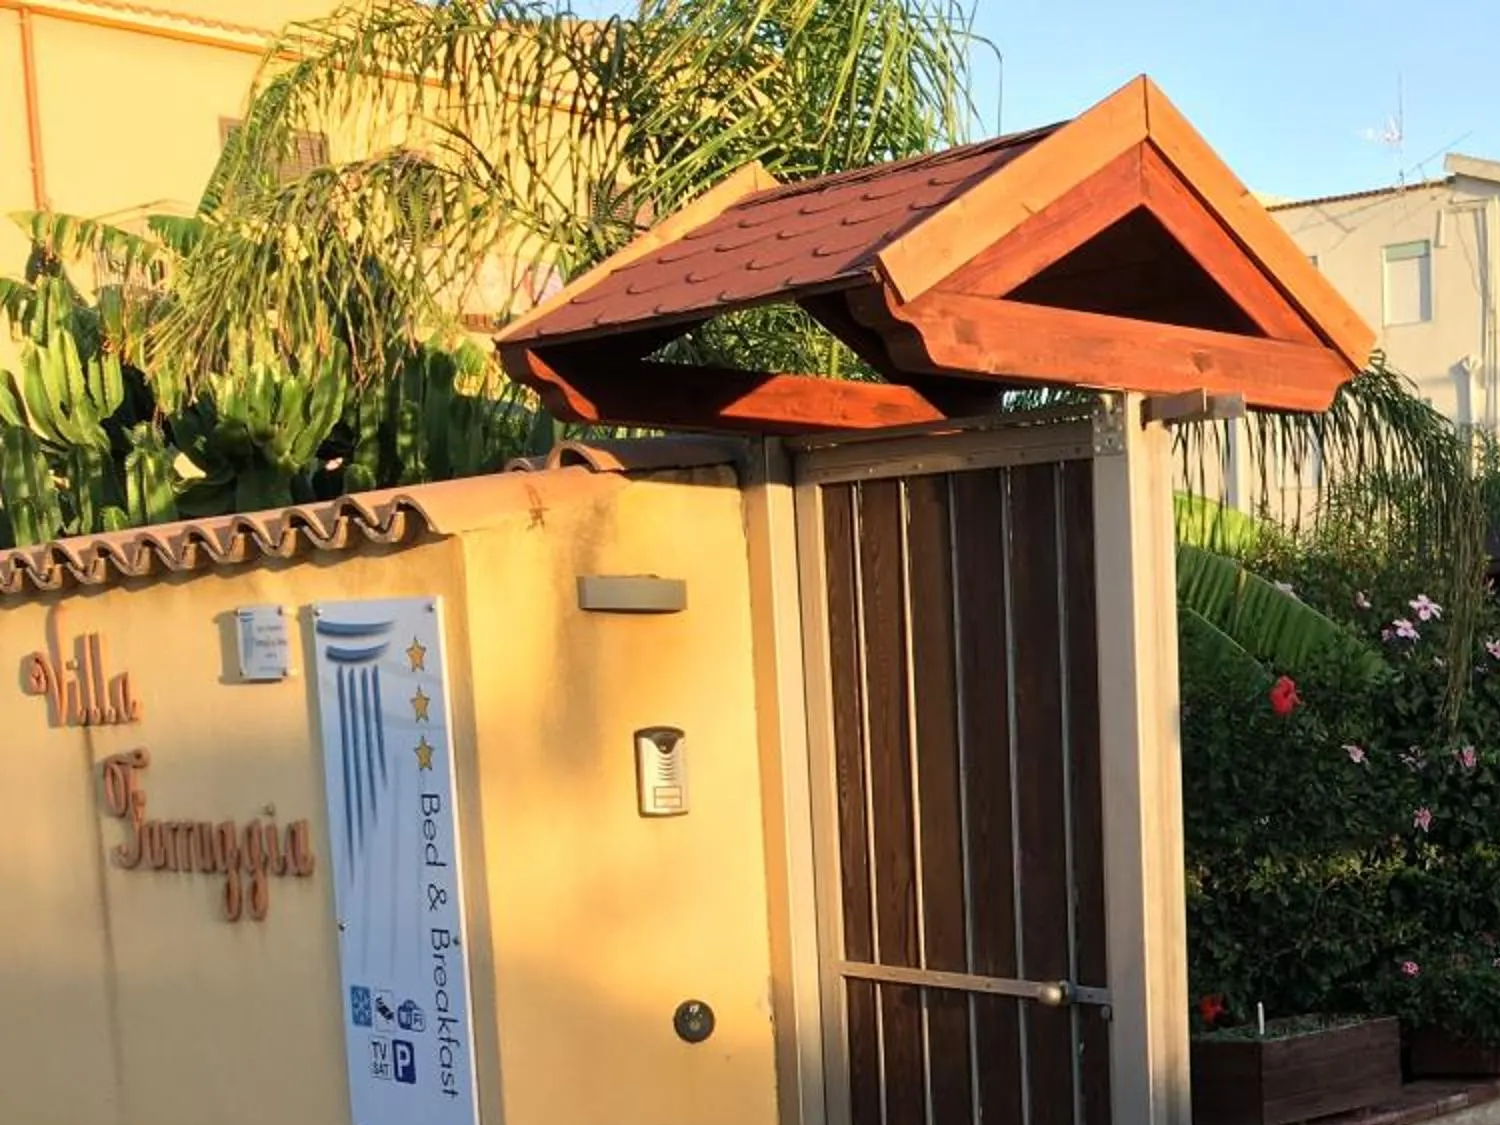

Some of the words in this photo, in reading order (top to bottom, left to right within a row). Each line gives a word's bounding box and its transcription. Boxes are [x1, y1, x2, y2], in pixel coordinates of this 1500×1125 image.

[24, 600, 141, 727] Villa
[420, 793, 447, 867] Bed
[427, 883, 447, 912] &
[430, 927, 460, 1099] Breakfast
[371, 1041, 388, 1060] TV
